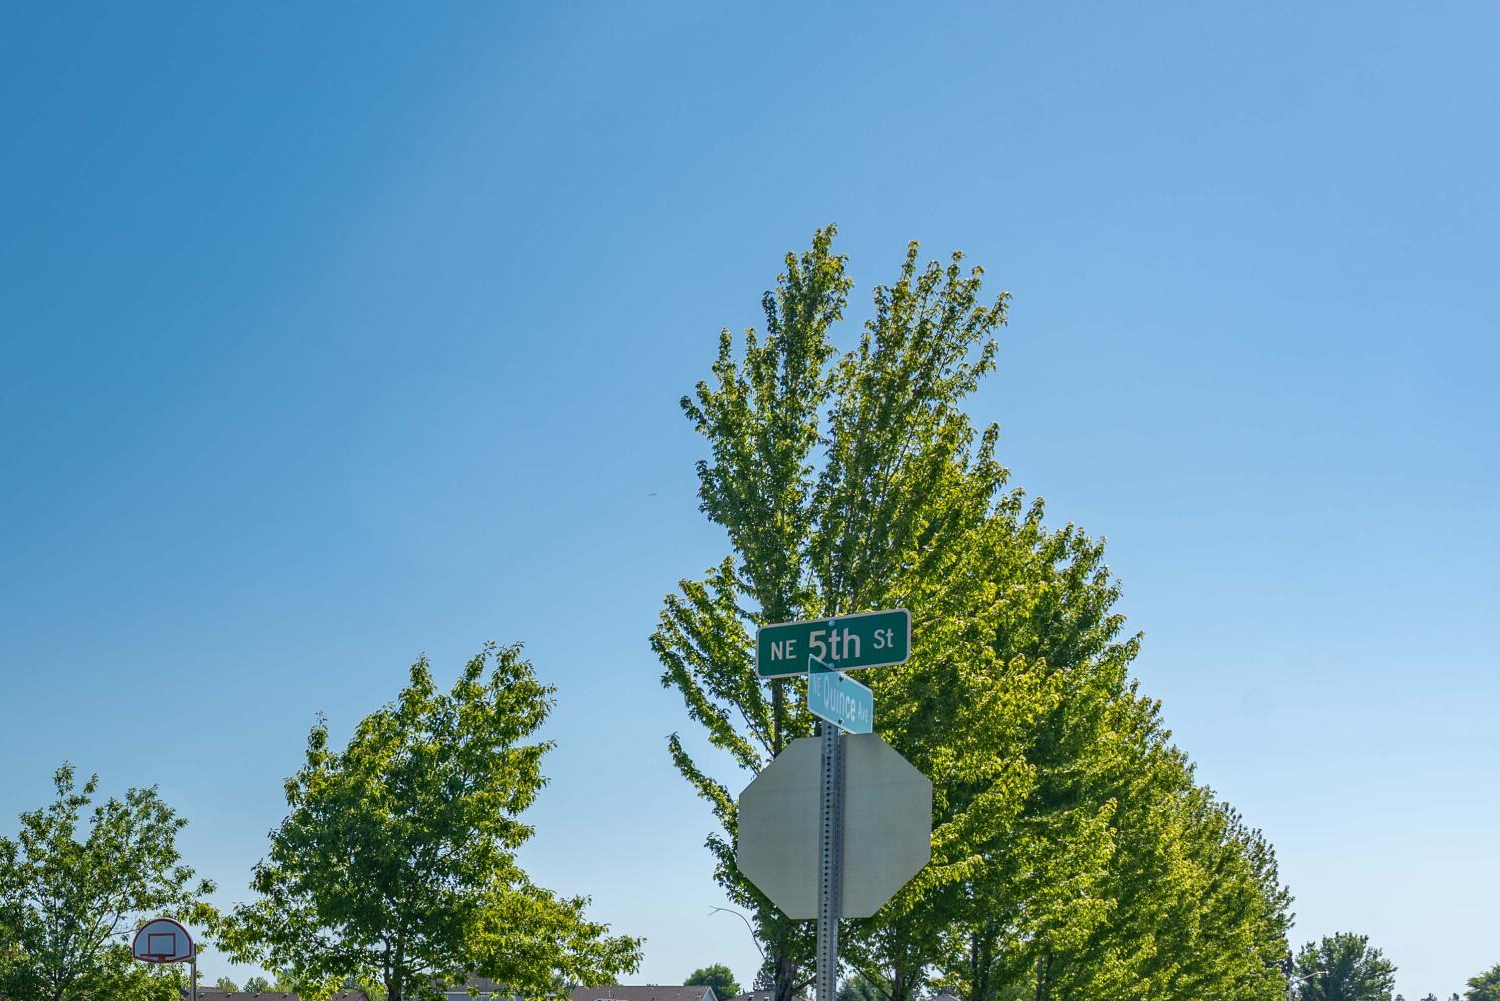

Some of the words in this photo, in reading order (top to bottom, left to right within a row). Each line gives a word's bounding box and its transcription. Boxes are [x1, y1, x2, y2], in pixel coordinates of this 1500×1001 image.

[771, 639, 797, 661] NE
[808, 627, 861, 662] 5th
[873, 628, 894, 649] St
[823, 674, 856, 722] Quince
